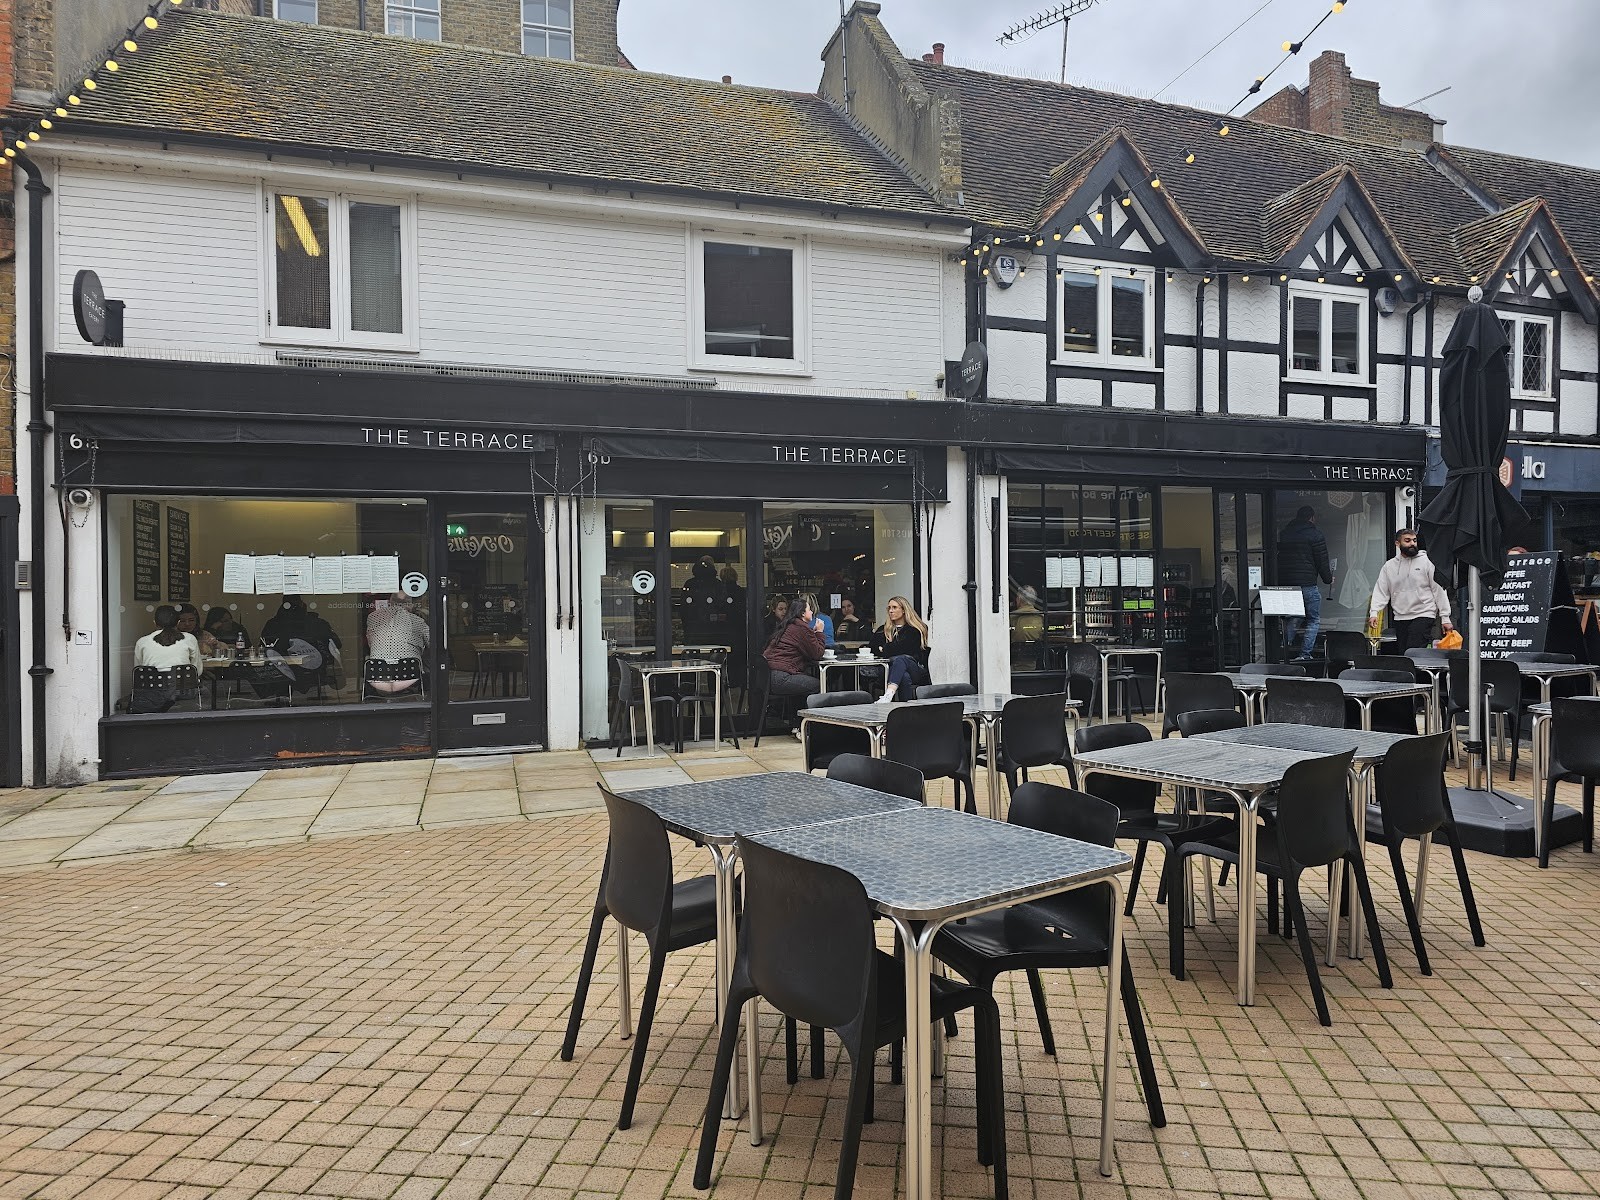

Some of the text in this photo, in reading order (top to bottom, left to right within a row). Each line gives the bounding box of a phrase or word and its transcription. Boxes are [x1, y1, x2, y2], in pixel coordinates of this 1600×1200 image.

[961, 361, 981, 377] TERRACE
[361, 428, 534, 449] THE TERRACE
[772, 446, 907, 464] THE TERRACE
[1323, 466, 1414, 480] THE TERRACE
[1508, 557, 1552, 567] errace
[1503, 569, 1526, 578] FFEE
[1500, 581, 1533, 590] AKFAST
[1493, 593, 1525, 602] BRUNCH
[1482, 604, 1530, 613] SANDWICHES
[1480, 616, 1540, 624] PERFOOD SALADS
[1487, 627, 1518, 636] PROTEIN
[1490, 639, 1510, 647] SALT
[1511, 639, 1533, 648] BEEF
[1480, 651, 1499, 659] SHLY
